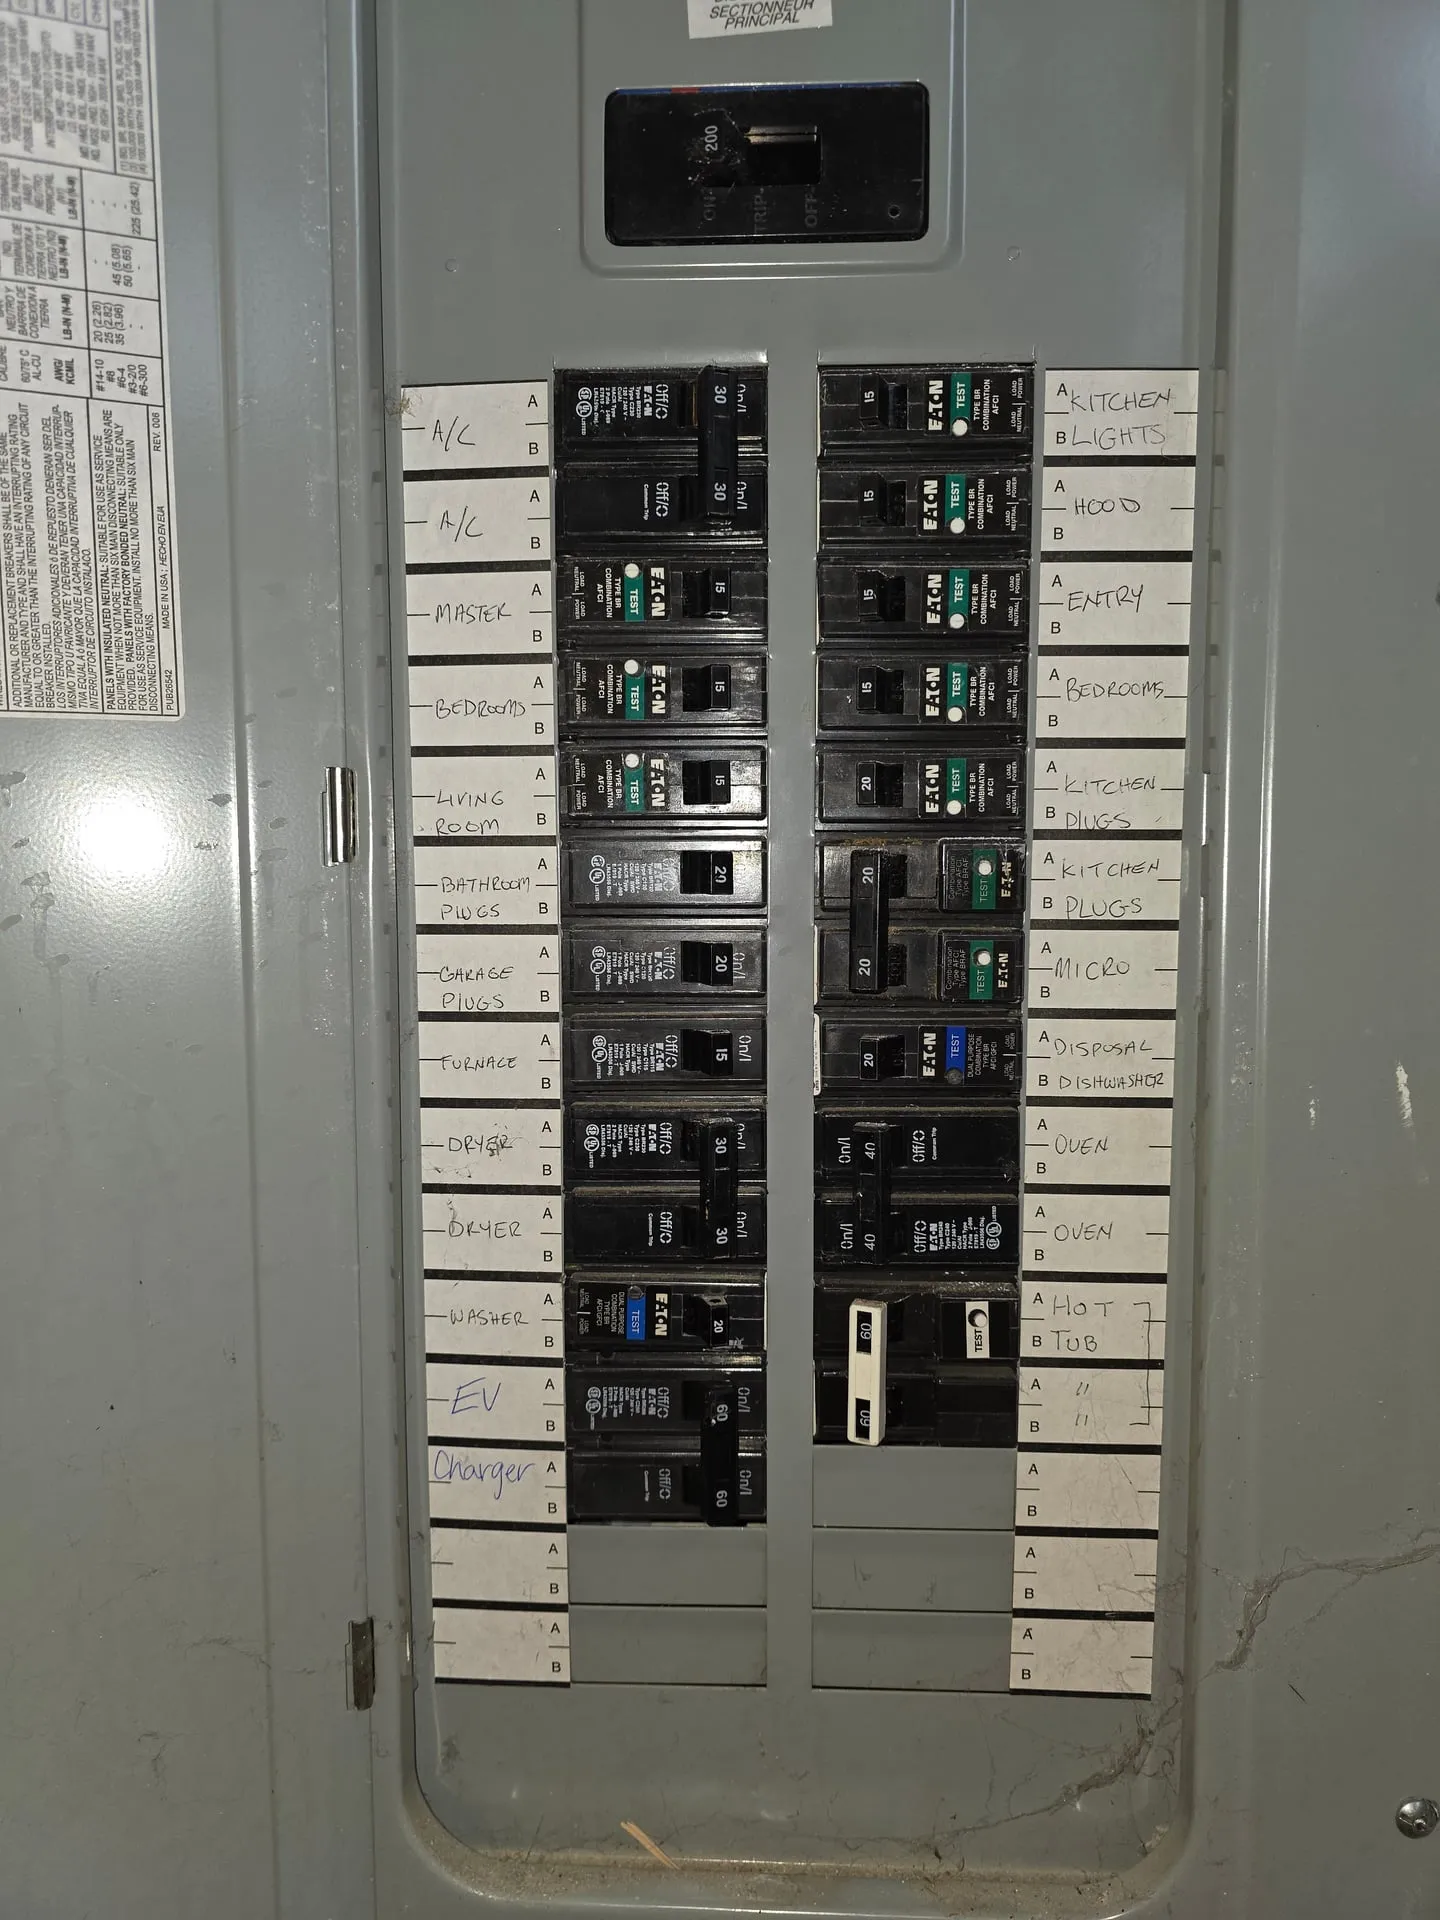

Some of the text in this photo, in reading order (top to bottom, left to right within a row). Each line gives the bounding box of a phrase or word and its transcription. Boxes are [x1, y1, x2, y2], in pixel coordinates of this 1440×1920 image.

[709, 0, 816, 20] SECTIONNEUR
[724, 12, 800, 30] PRINCIPAL
[704, 124, 718, 152] 200
[93, 330, 103, 343] 20
[714, 385, 727, 404] 30
[864, 390, 875, 403] 15
[956, 382, 966, 408] TEST
[1056, 383, 1068, 397] A
[527, 394, 538, 408] A
[973, 389, 981, 421] TYPE BR
[982, 379, 990, 431] COMBINATION
[1070, 388, 1171, 414] KITCHEN
[153, 431, 161, 452] REV.
[432, 416, 476, 451] A/C
[1056, 431, 1067, 444] B
[1071, 424, 1166, 450] LIGHTS
[528, 442, 539, 455] B
[714, 482, 727, 501] 30
[863, 490, 874, 502] 15
[950, 481, 960, 508] TEST
[1075, 497, 1140, 516] HOOD
[439, 506, 483, 542] A/C
[605, 567, 613, 618] COMBINATION
[715, 582, 726, 593] 15
[863, 589, 874, 601] 15
[954, 576, 964, 603] TEST
[160, 573, 171, 629] MADE IN USA
[614, 597, 622, 609] BR
[629, 588, 639, 615] TEST
[1068, 584, 1144, 613] ENTRY
[435, 603, 512, 624] MASTER
[6, 580, 22, 708] ADDITIONAL OR REPLACEMENT
[101, 564, 116, 710] PANELS WITH INSULATED NEUTRAL:
[146, 645, 158, 711] DISCONNECTING
[715, 681, 725, 692] 15
[862, 682, 873, 693] 15
[952, 671, 961, 697] TEST
[44, 670, 55, 709] BREAKER
[164, 670, 174, 711] PUB26542
[606, 664, 614, 714] COMBINATION
[630, 685, 640, 712] TEST
[1066, 677, 1164, 703] BEDROOMS
[436, 699, 526, 719] BEDROOMS
[616, 694, 622, 705] BR
[715, 775, 725, 786] 15
[861, 776, 872, 791] 20
[951, 768, 961, 793] TEST
[1064, 774, 1156, 795] KITCHEN
[437, 790, 504, 807] LIVING
[630, 780, 640, 805] TEST
[436, 818, 500, 834] ROOM
[714, 865, 727, 883] 20
[862, 866, 874, 884] 20
[1061, 858, 1160, 879] KITCHEN
[442, 876, 530, 893] BATHROOM
[980, 880, 989, 901] TEST
[1065, 896, 1143, 920] PLUGS
[715, 954, 728, 972] 20
[858, 958, 870, 976] 20
[1055, 957, 1130, 981] MICRO
[439, 966, 514, 983] GARAGE
[976, 970, 985, 993] TEST
[716, 1048, 727, 1061] 15
[951, 1034, 959, 1058] TEST
[1054, 1038, 1153, 1058] DISPOSAL
[440, 1056, 517, 1071] FURNACE
[863, 1053, 874, 1067] 20
[715, 1137, 727, 1154] 30
[864, 1142, 876, 1160] 40
[1055, 1134, 1109, 1155] OVEN
[448, 1220, 522, 1239] DRYER
[716, 1228, 727, 1244] 30
[1054, 1221, 1113, 1242] OVEN
[864, 1233, 875, 1251] 40
[1033, 1292, 1044, 1305] A
[1052, 1294, 1114, 1318] HOT
[450, 1309, 529, 1326] WASHER
[631, 1310, 640, 1333] TEST
[714, 1320, 724, 1333] 20
[860, 1322, 872, 1340] 60
[974, 1329, 982, 1353] TEST
[1032, 1335, 1042, 1347] B
[1050, 1330, 1097, 1353] TUB
[451, 1376, 502, 1415] EV
[716, 1404, 728, 1422] 60
[860, 1410, 871, 1427] 60
[433, 1449, 535, 1500] Charger
[716, 1490, 728, 1508] 60
[548, 1543, 559, 1555] A
[549, 1583, 559, 1594] B
